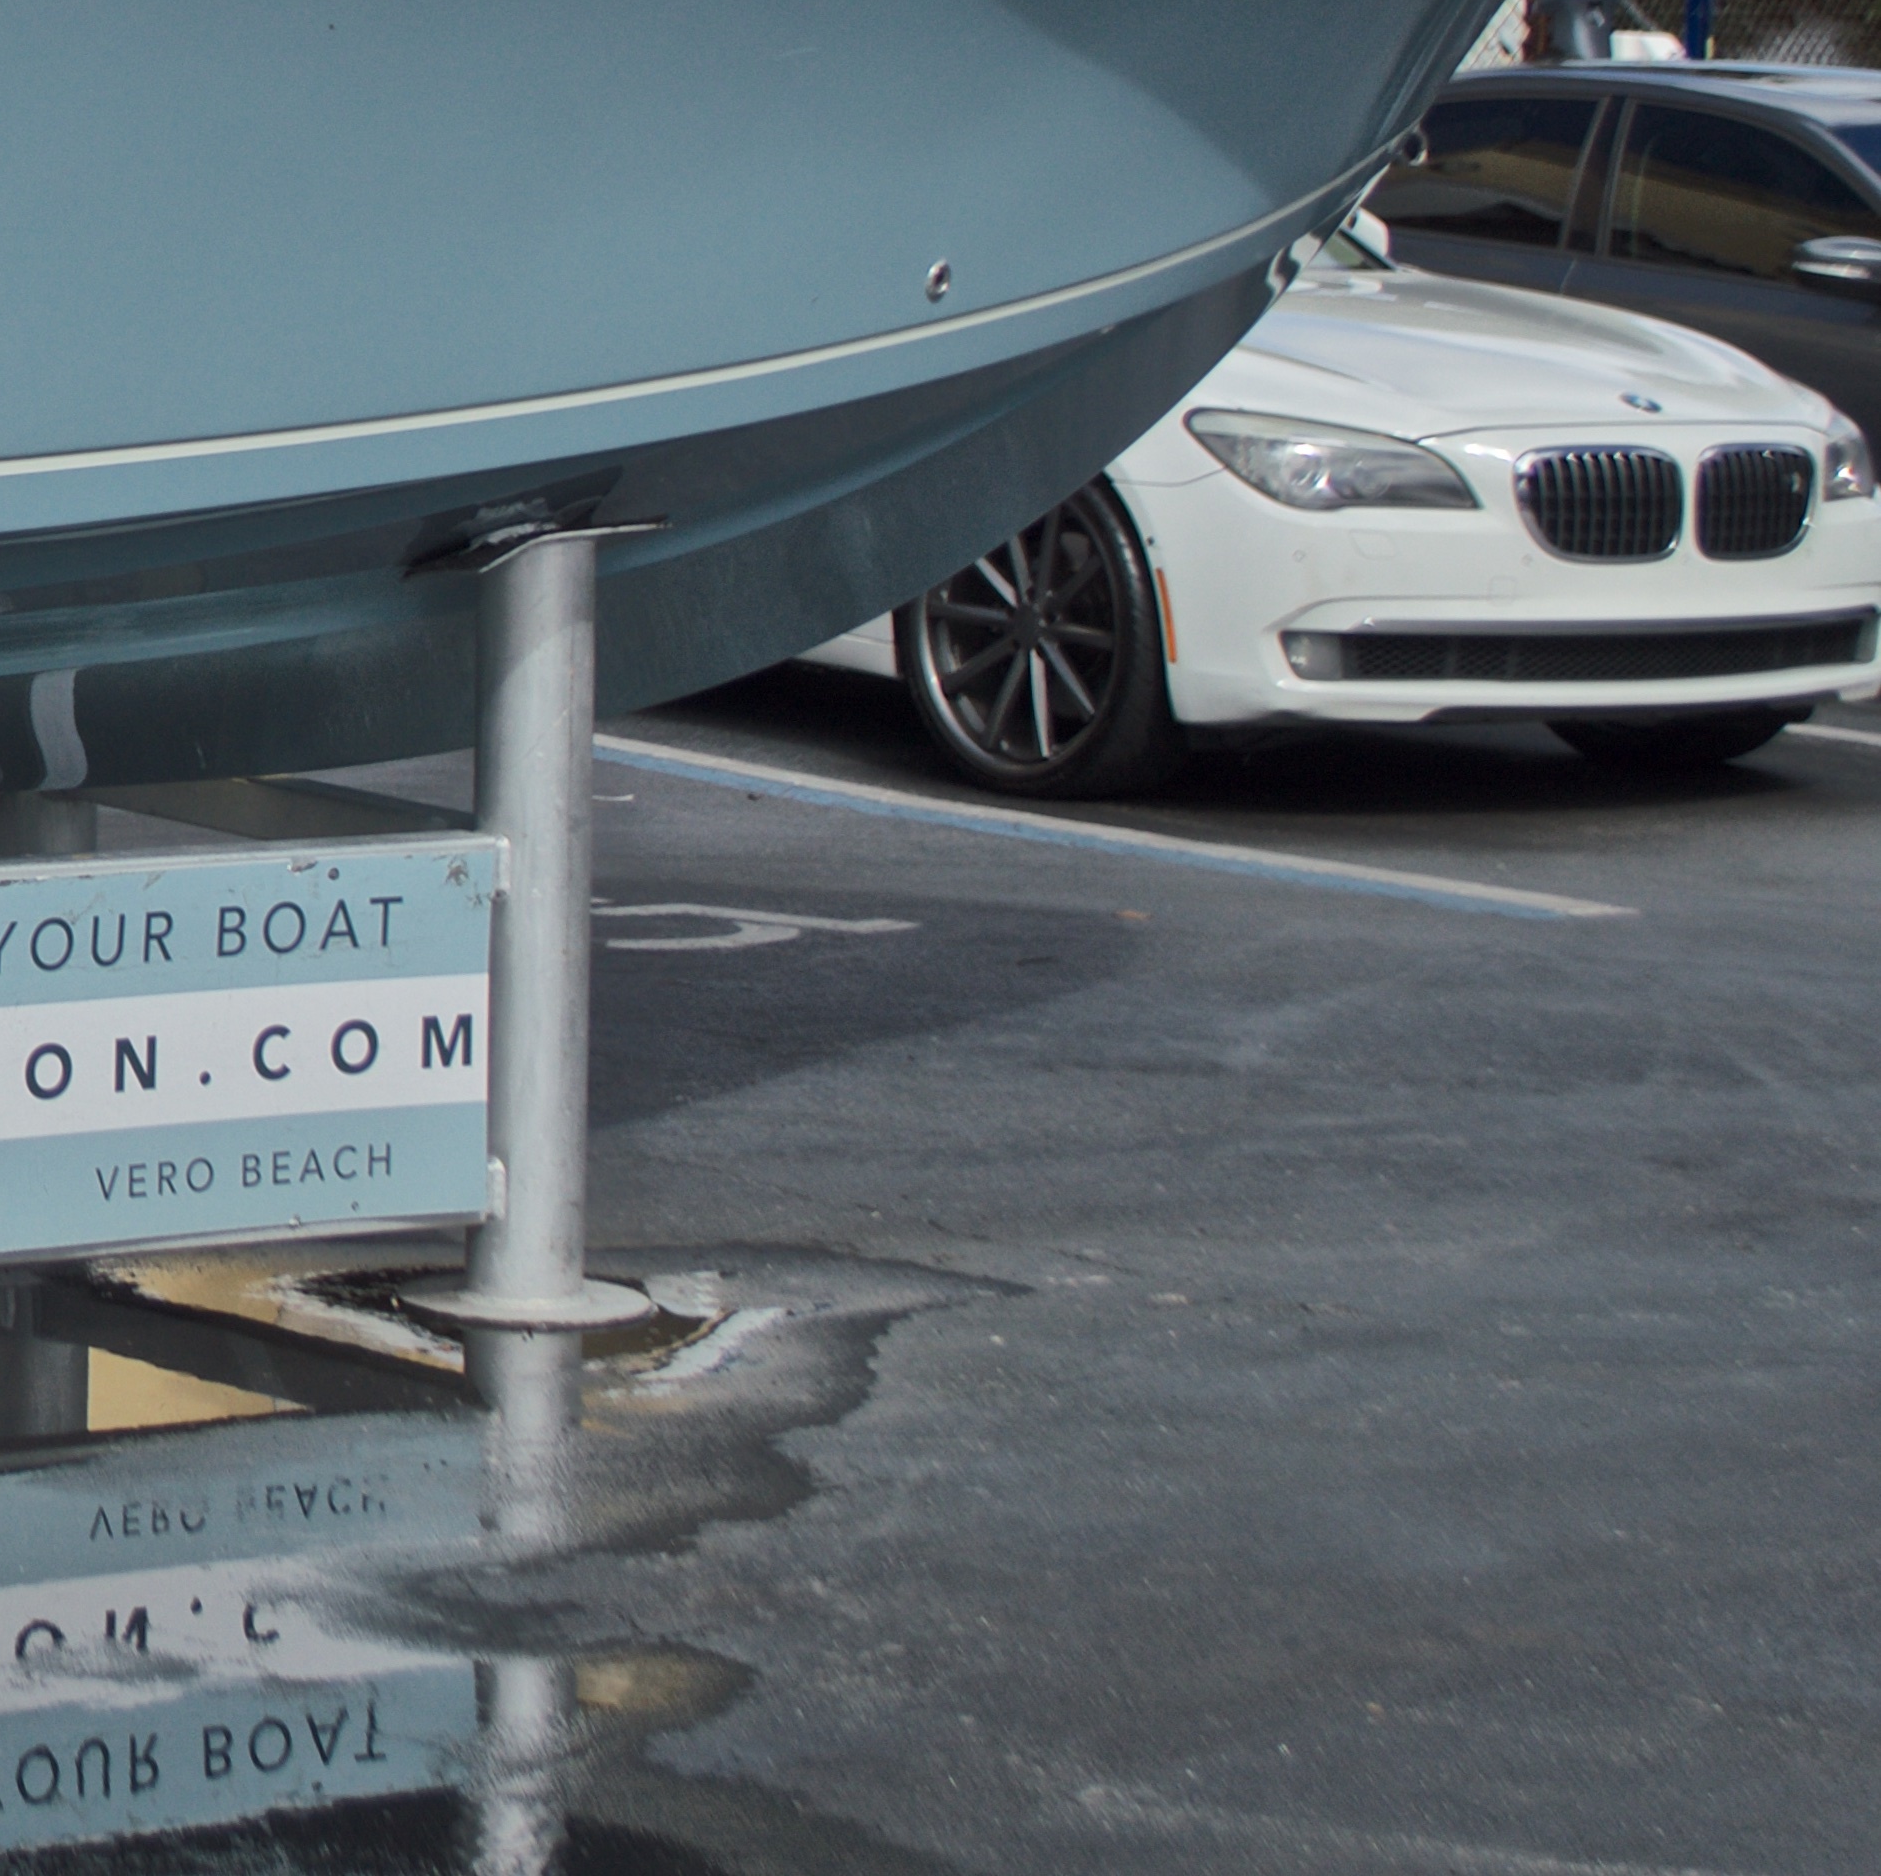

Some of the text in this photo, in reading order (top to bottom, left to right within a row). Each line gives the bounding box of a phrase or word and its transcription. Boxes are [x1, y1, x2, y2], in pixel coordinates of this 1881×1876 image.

[215, 895, 406, 958] BOAT
[95, 1140, 395, 1202] VERO BEACH
